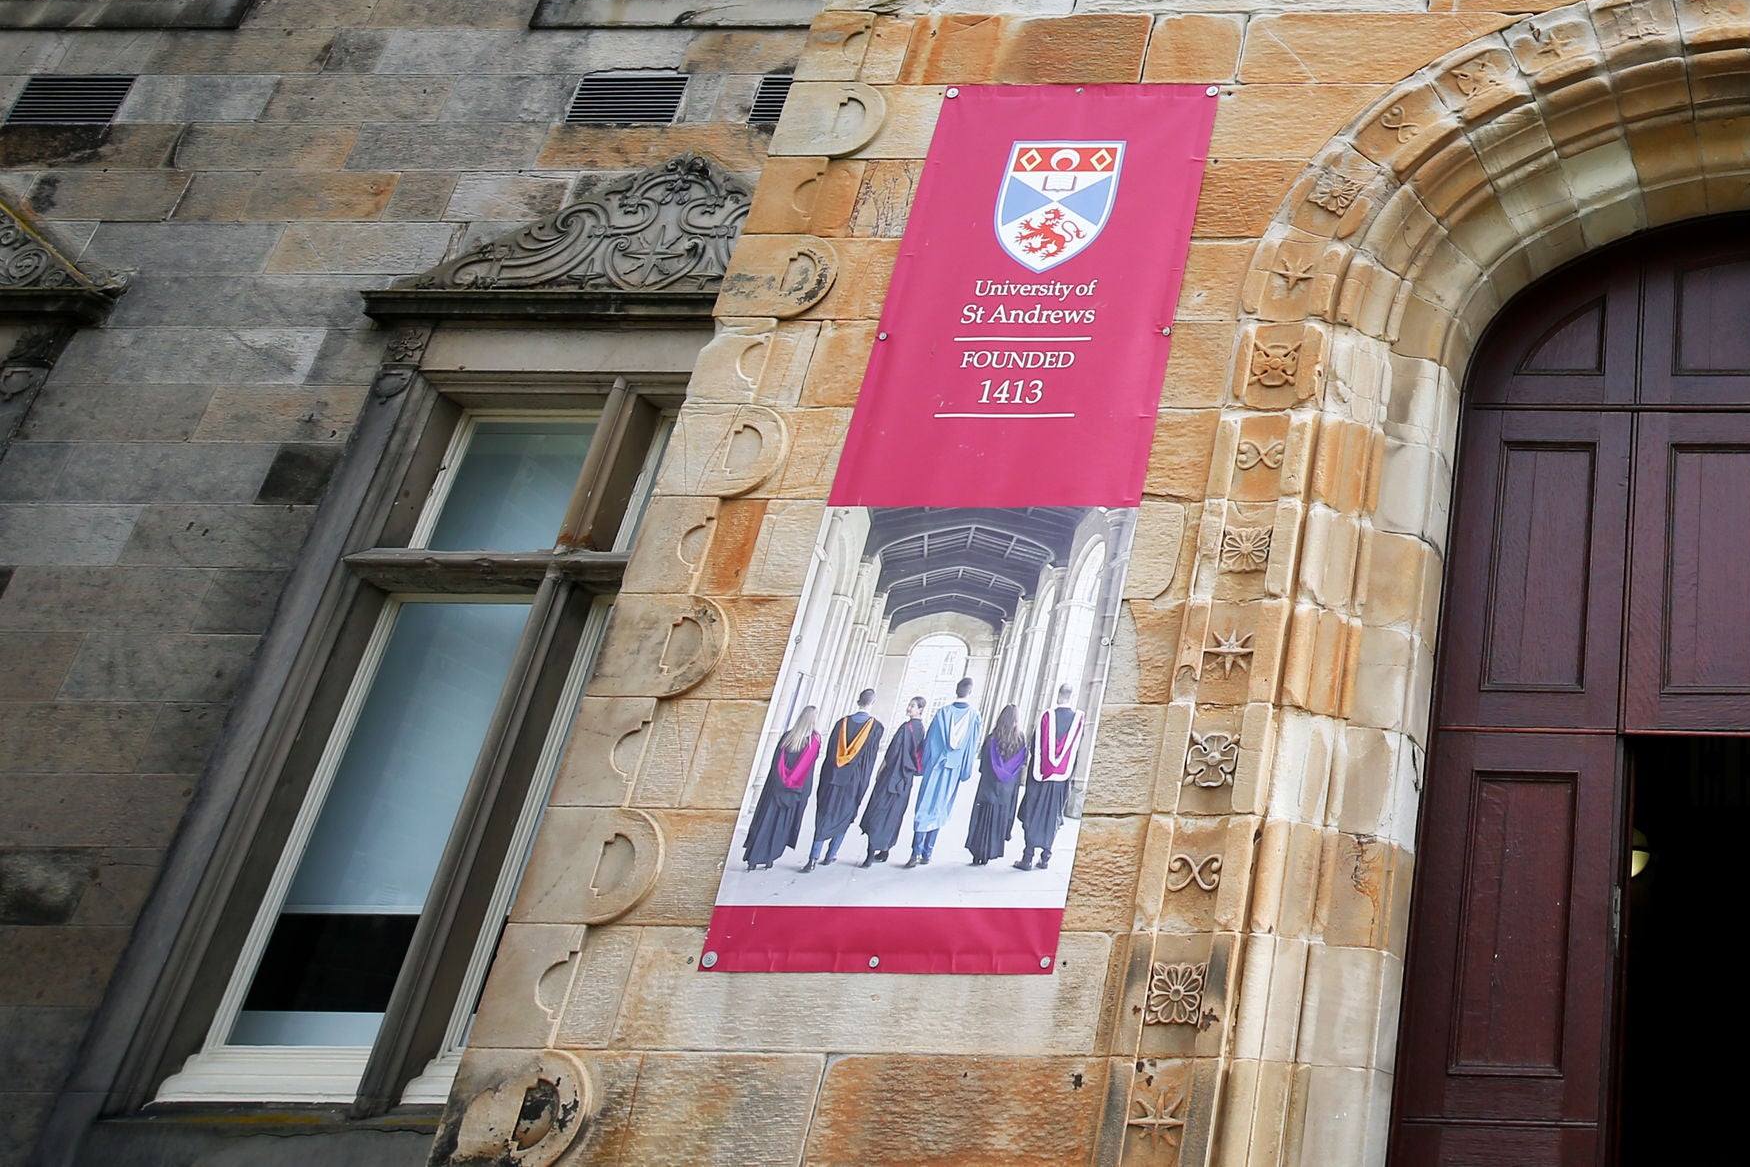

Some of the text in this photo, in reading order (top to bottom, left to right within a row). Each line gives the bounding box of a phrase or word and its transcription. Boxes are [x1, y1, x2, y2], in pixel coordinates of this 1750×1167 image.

[974, 280, 1098, 301] University of
[960, 304, 1096, 324] St Andrews
[959, 351, 1075, 369] FOUNDED
[977, 380, 1043, 404] 1413
